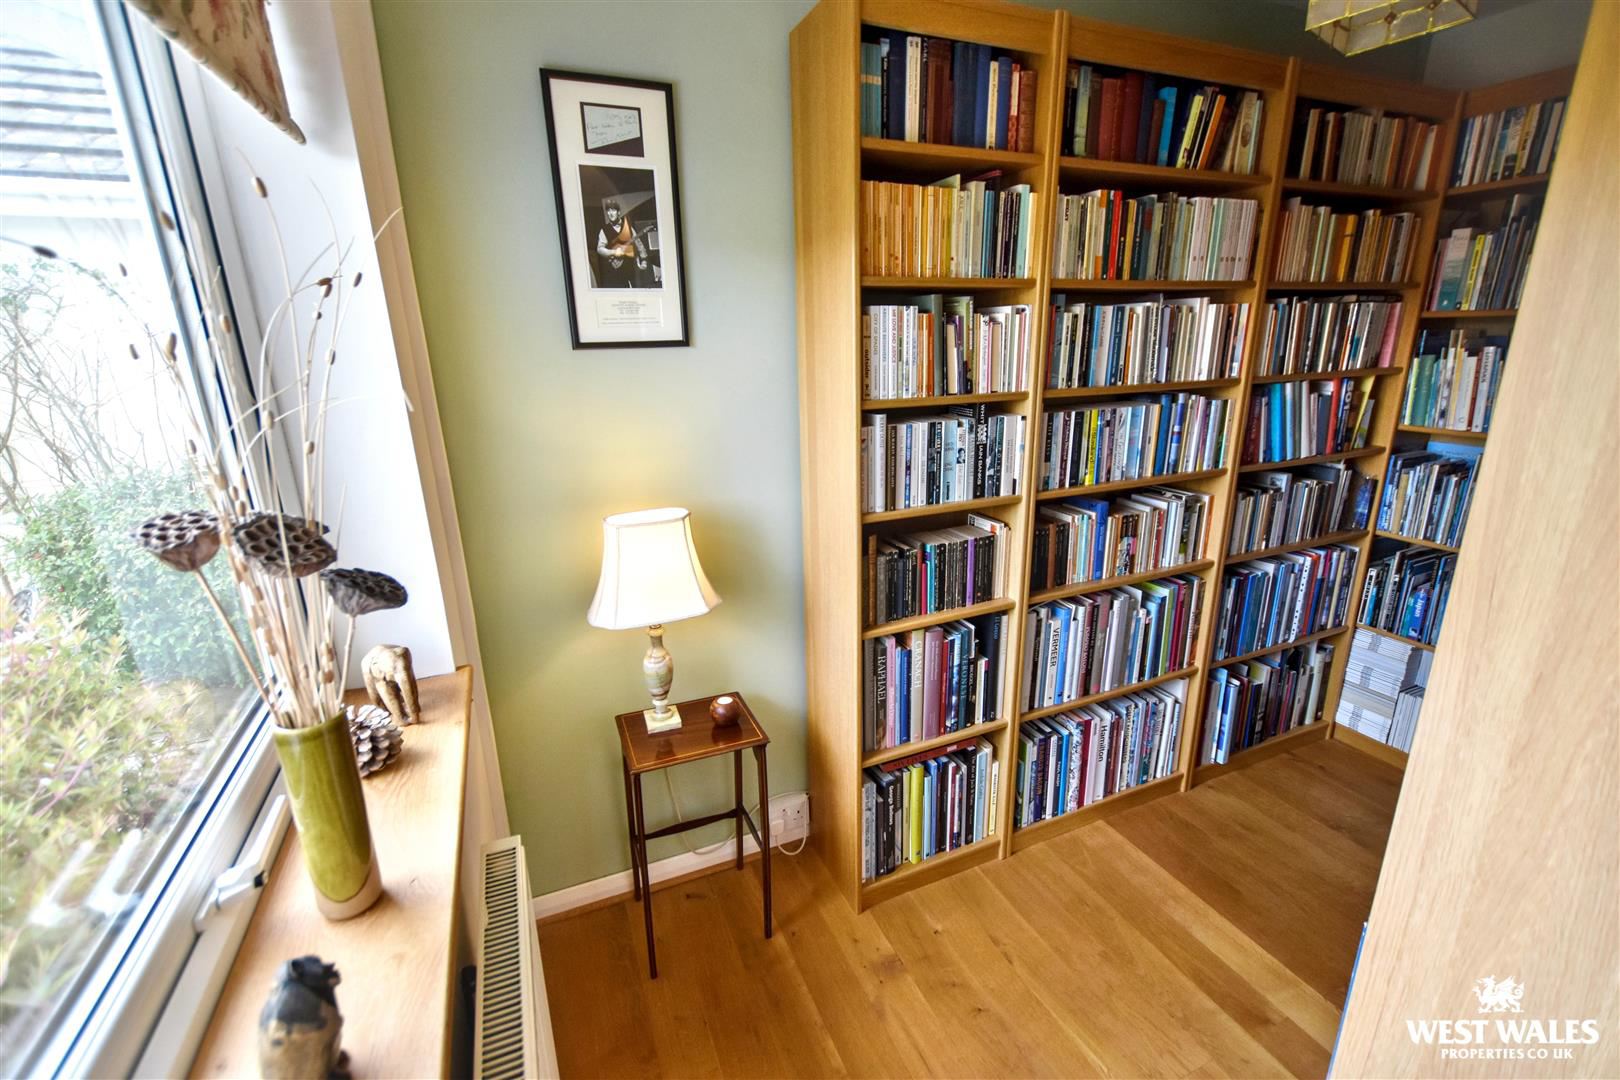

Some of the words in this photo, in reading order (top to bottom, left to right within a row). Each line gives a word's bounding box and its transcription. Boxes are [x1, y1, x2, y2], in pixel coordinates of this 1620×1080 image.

[1415, 599, 1424, 618] Japan
[914, 640, 923, 688] CRANACH
[1050, 627, 1060, 667] VERMEER
[877, 656, 887, 704] RAPHAEL
[960, 654, 968, 700] VERONESE
[1098, 724, 1108, 762] Hamilton
